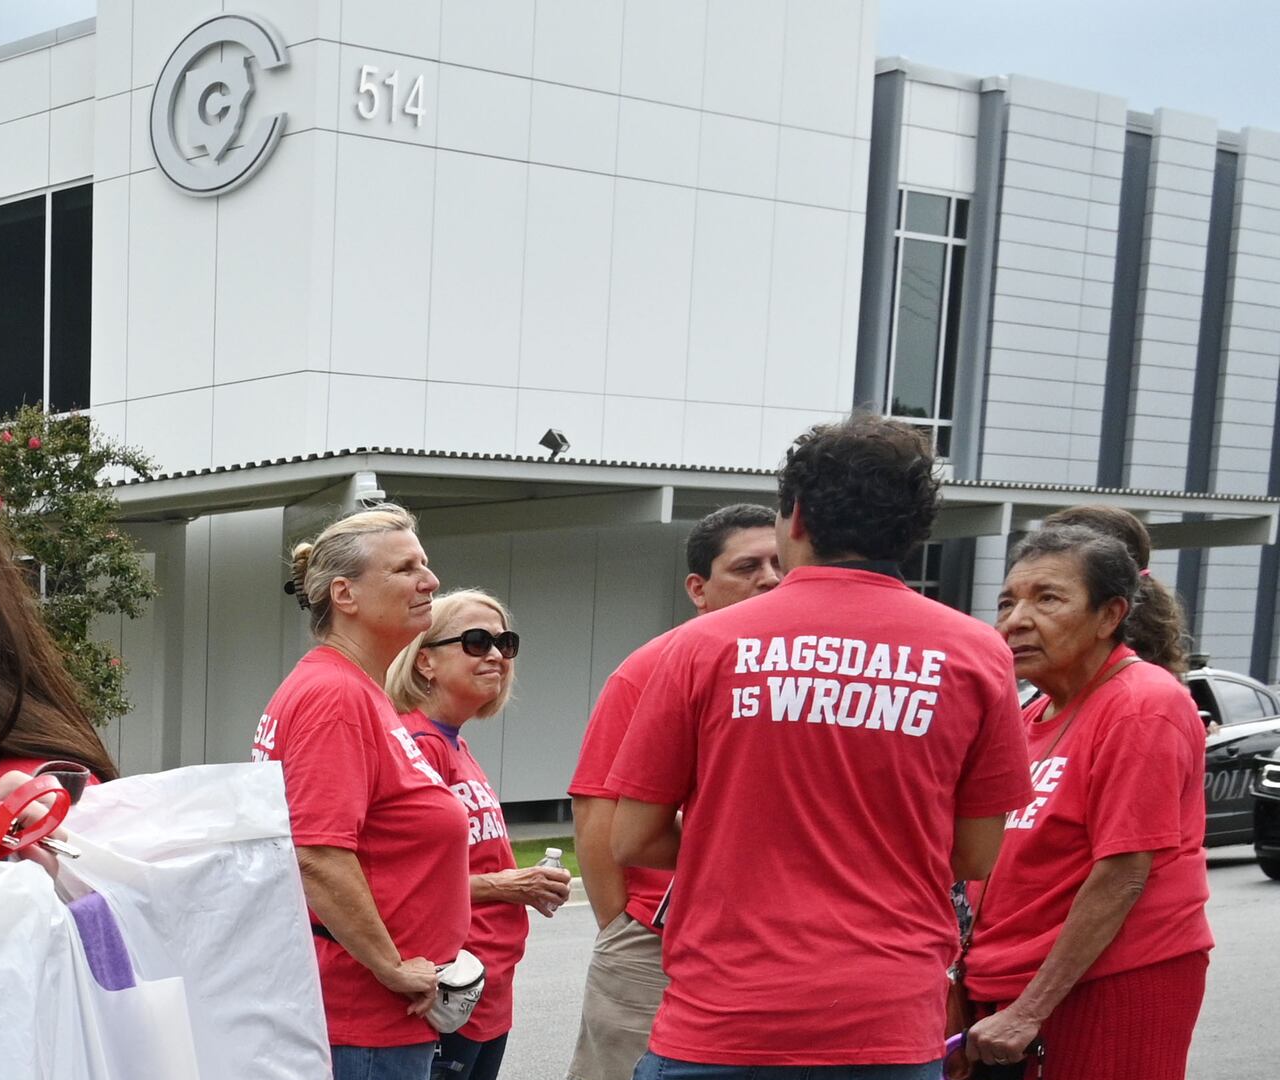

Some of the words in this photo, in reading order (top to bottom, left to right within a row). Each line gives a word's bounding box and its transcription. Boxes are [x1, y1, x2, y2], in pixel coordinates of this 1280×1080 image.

[357, 64, 427, 128] 514
[734, 635, 947, 687] RAGSDALE
[731, 686, 760, 719] IS
[767, 677, 939, 737] WRONG
